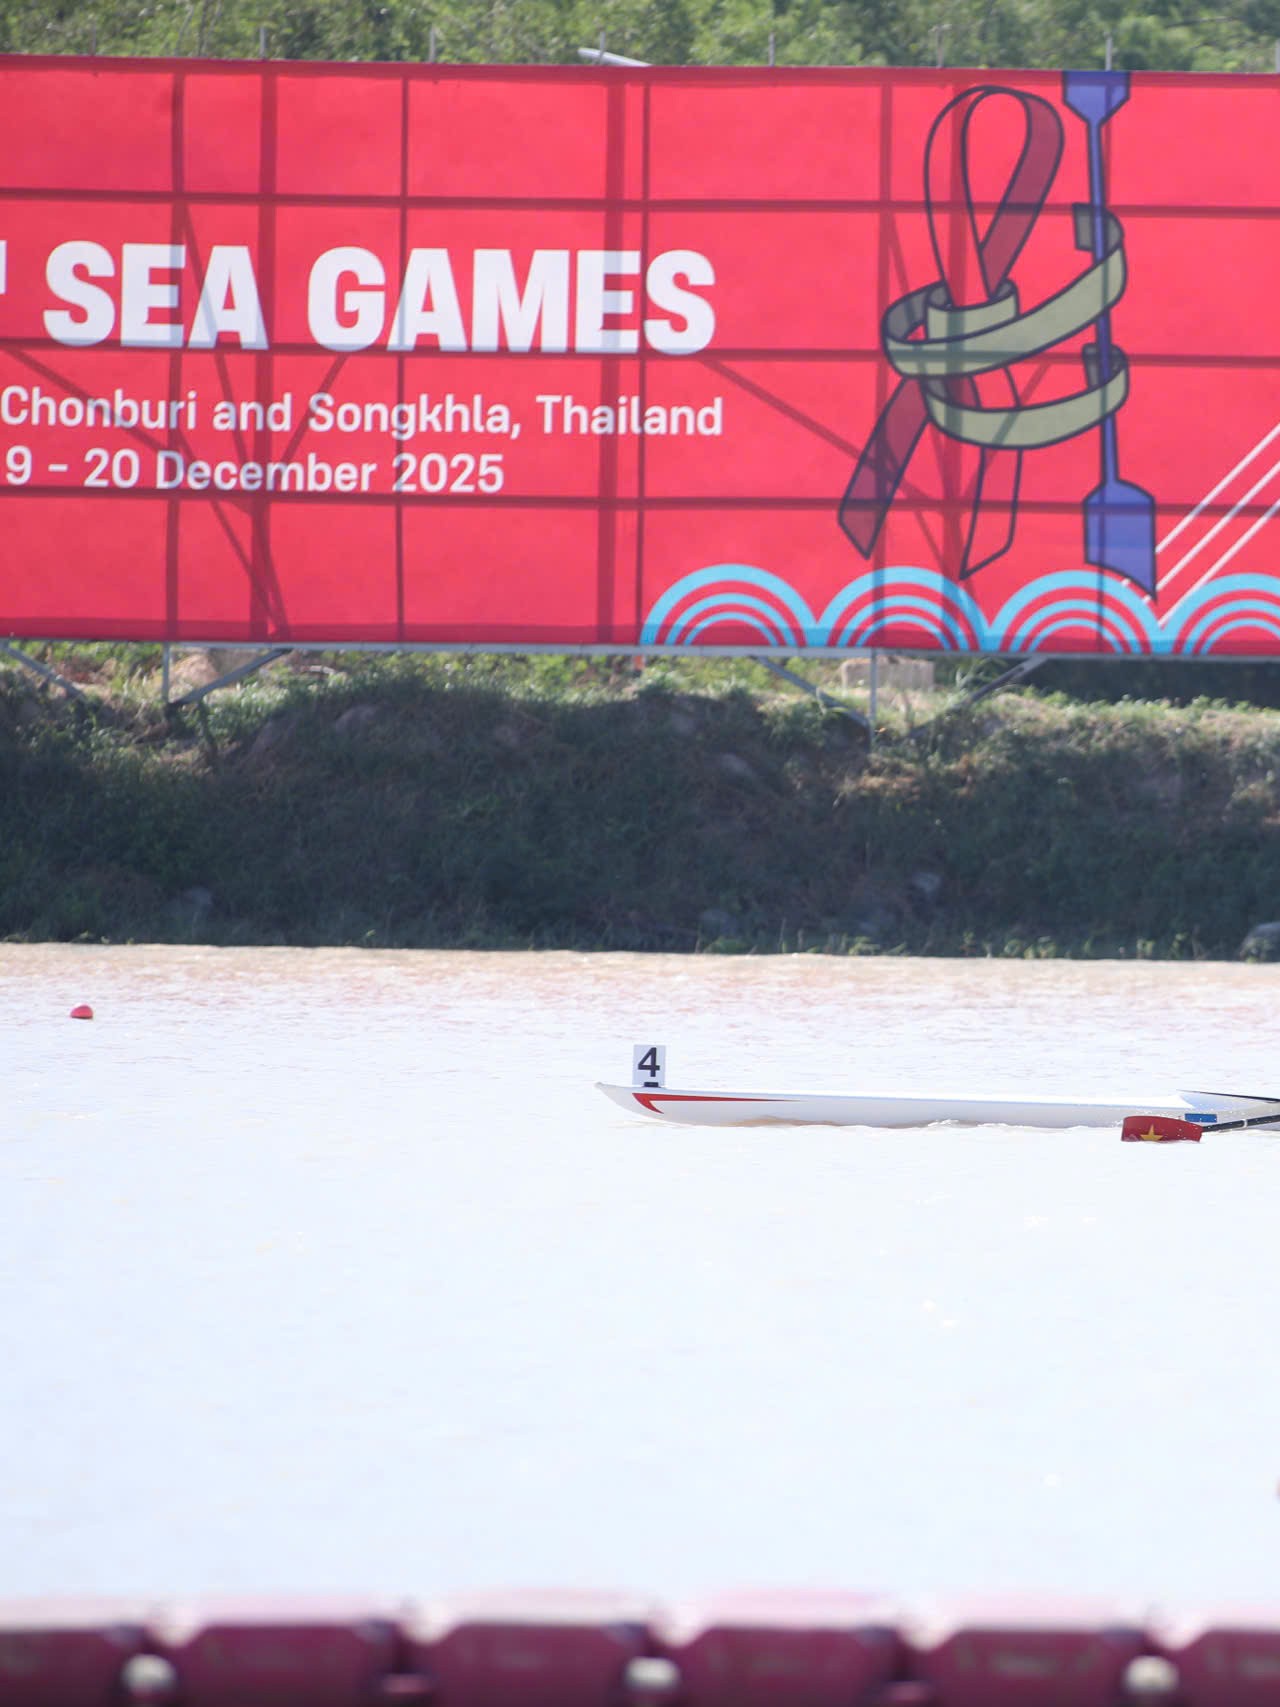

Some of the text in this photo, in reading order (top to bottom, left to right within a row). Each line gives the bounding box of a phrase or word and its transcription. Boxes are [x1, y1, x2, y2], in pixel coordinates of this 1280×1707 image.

[43, 240, 269, 349] SEA
[307, 246, 717, 355] GAMES
[1, 385, 723, 440] Chonburi and Songkhla, Thailand
[6, 445, 33, 485] 9
[84, 447, 141, 488] 20
[156, 450, 377, 492] December
[391, 452, 505, 493] 2025
[637, 1047, 661, 1077] 4
